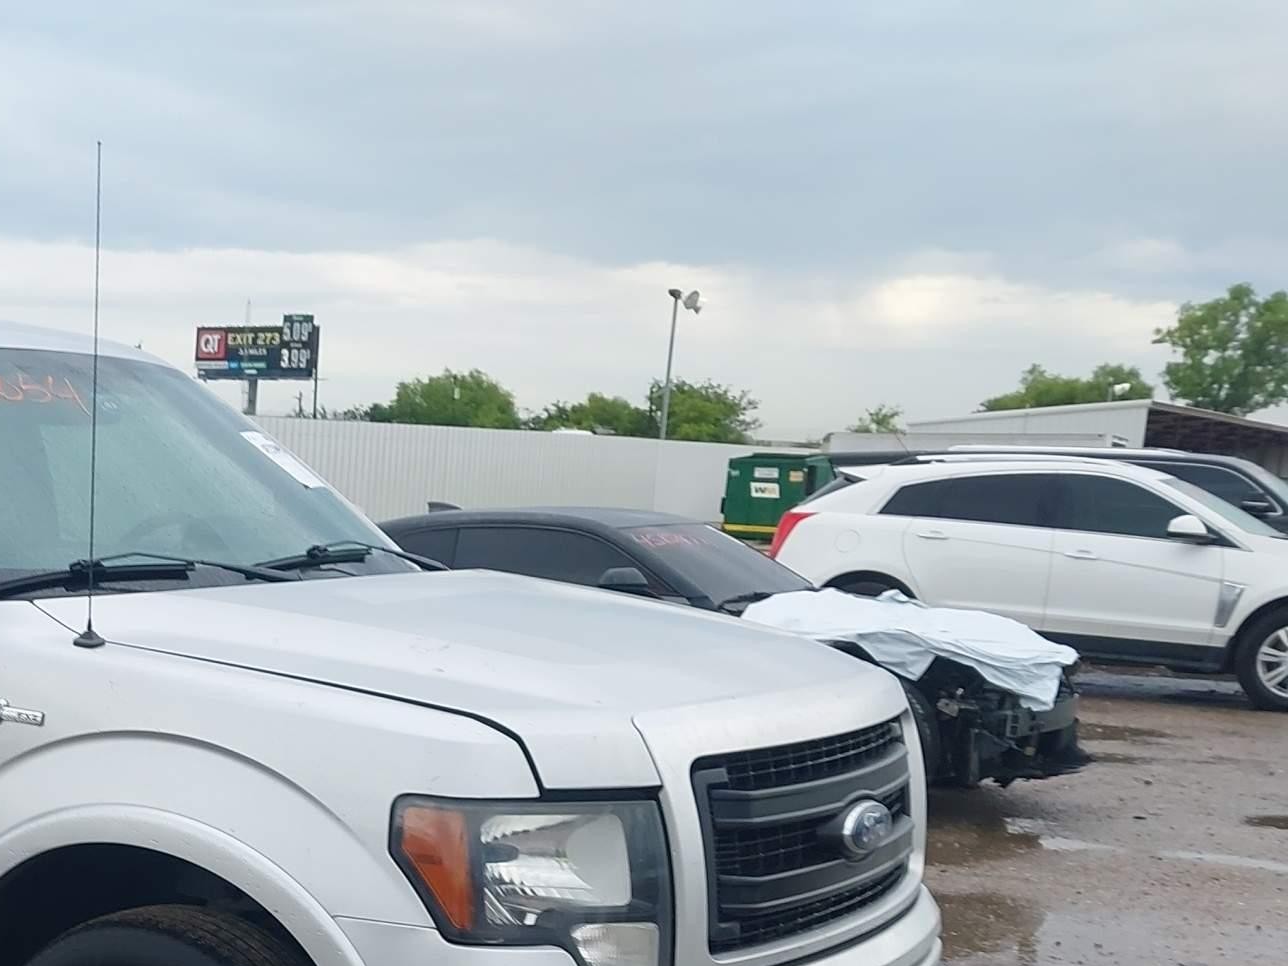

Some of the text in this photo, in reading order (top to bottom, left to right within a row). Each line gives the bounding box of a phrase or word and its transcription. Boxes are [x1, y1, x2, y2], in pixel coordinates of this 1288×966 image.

[199, 332, 221, 354] QT
[227, 331, 280, 346] EXIT 273
